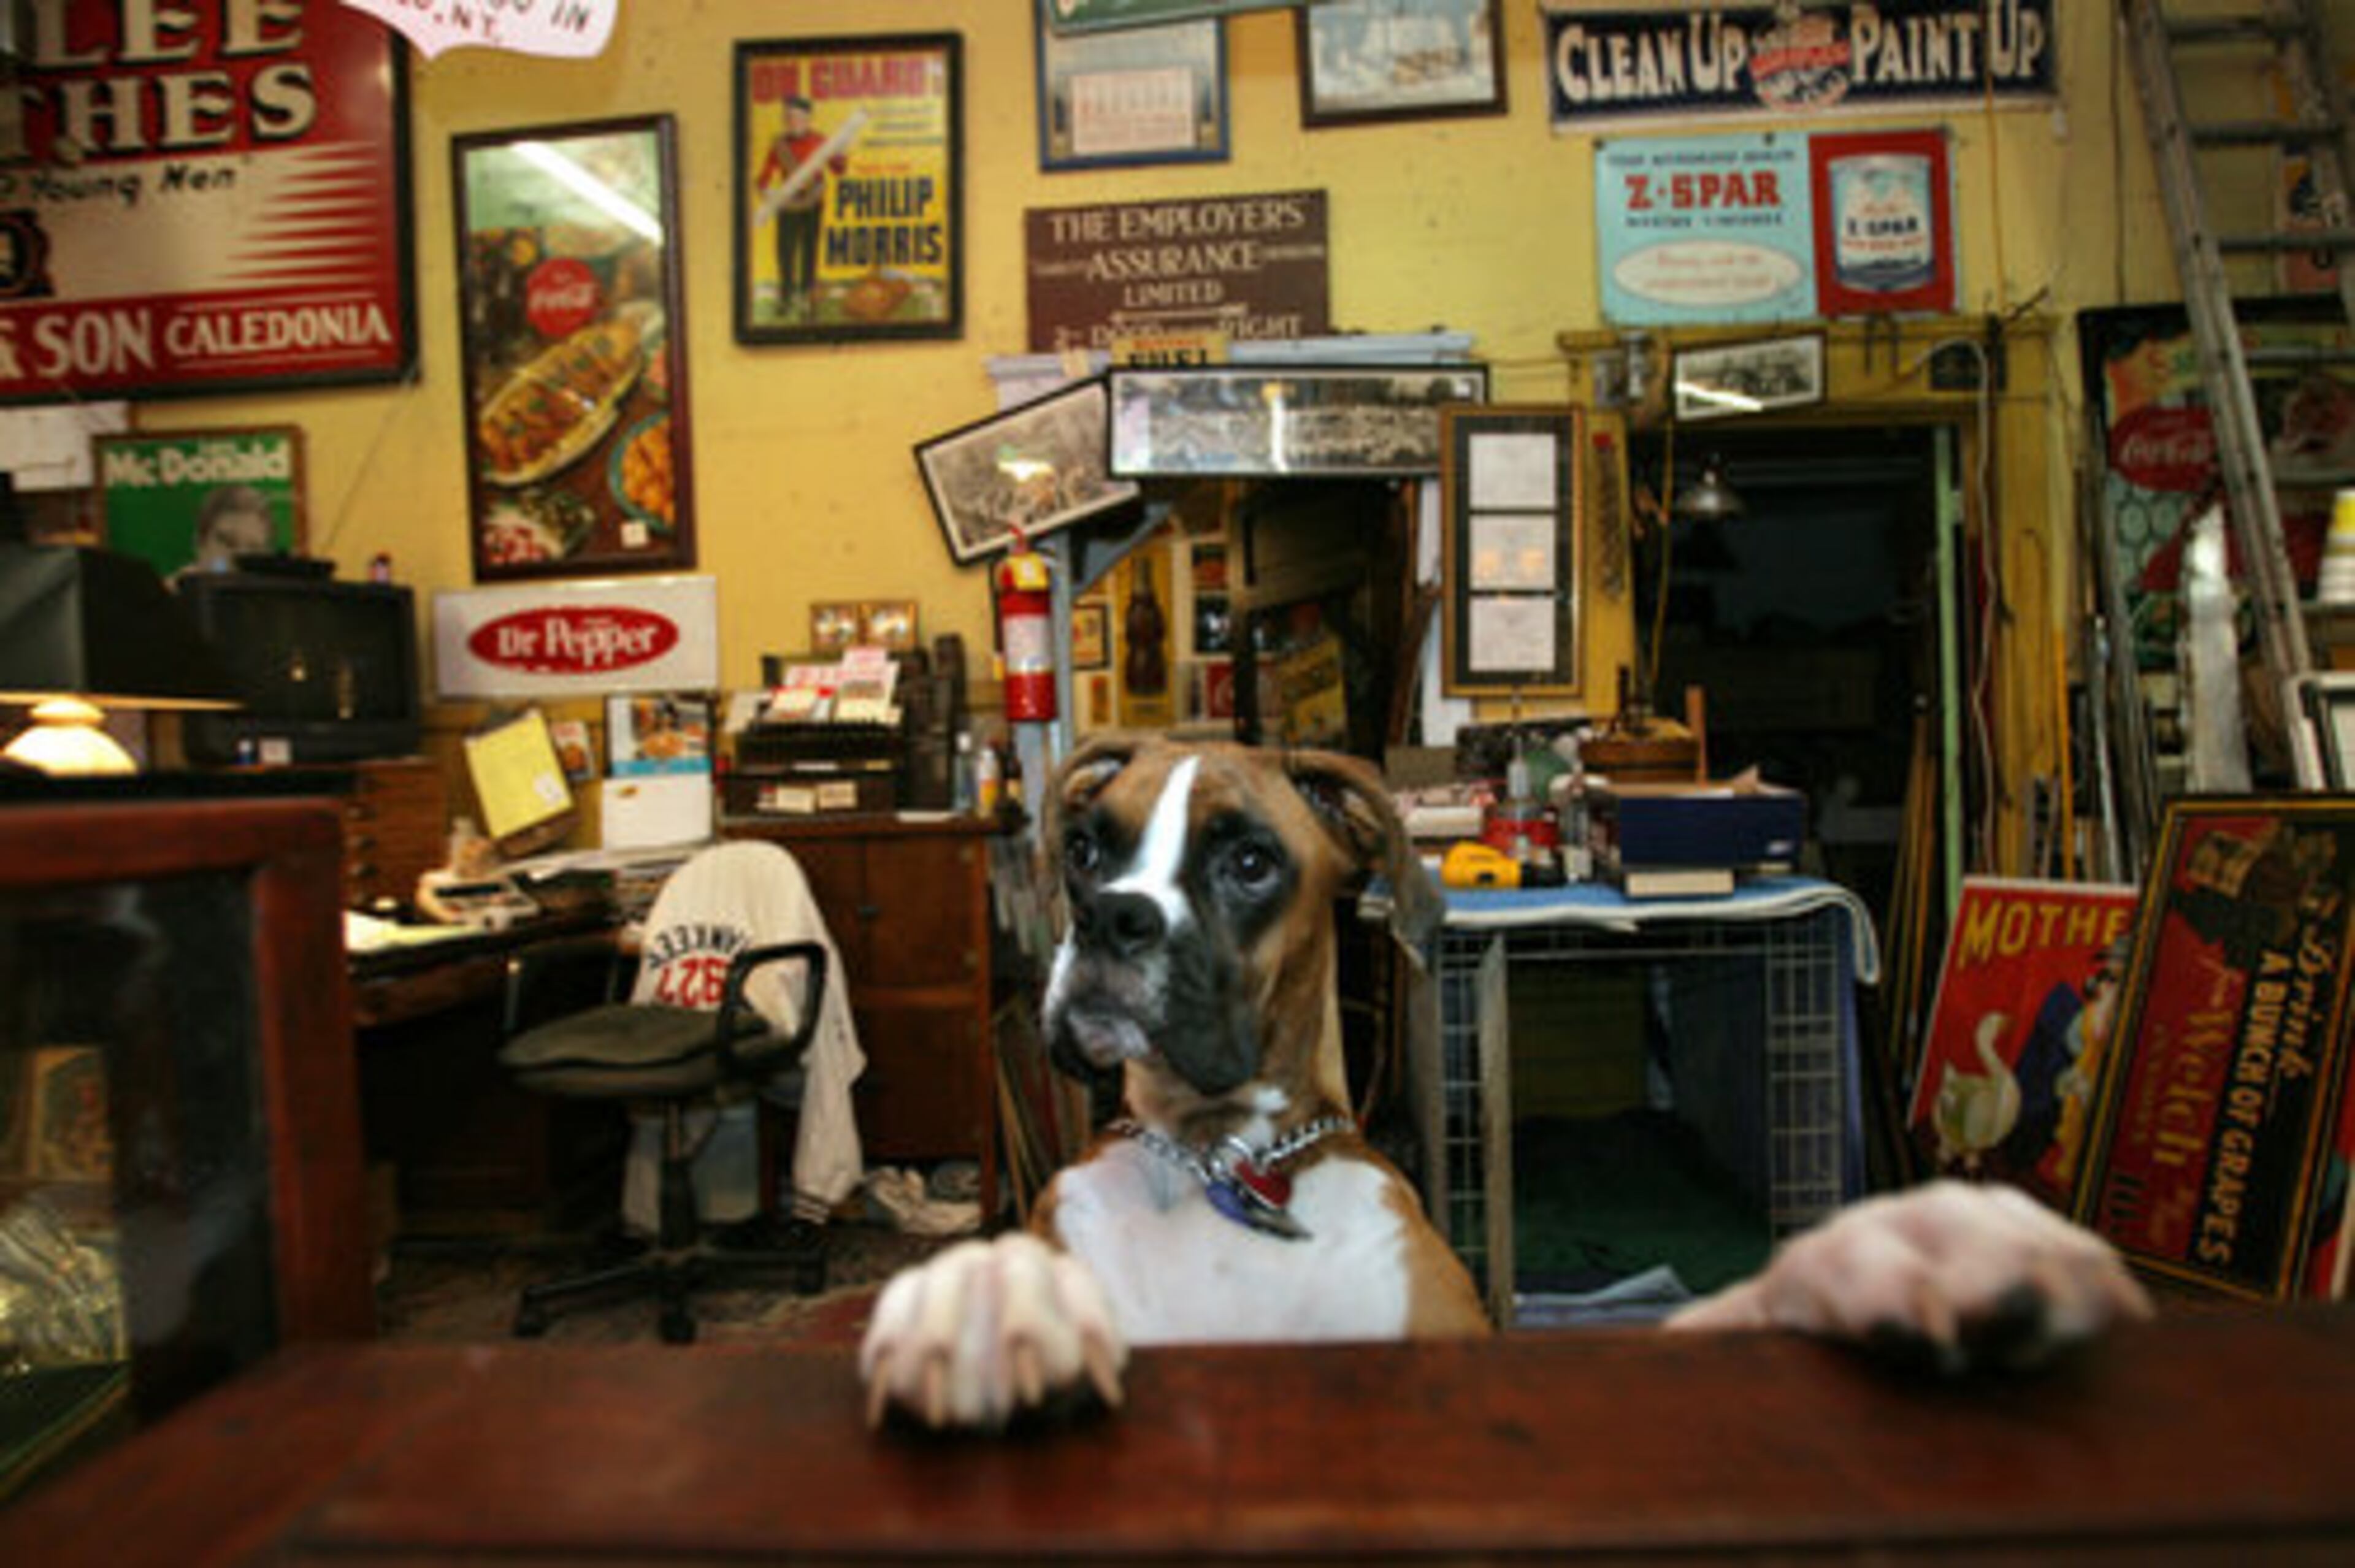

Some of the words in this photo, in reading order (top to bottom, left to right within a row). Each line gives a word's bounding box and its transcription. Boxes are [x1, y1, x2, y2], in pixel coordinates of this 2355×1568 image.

[1557, 23, 1687, 103] CLEAN
[1850, 8, 1980, 83] PAINT
[1989, 0, 2047, 78] UP
[158, 161, 238, 191] Men
[837, 176, 934, 220] PHILIP
[824, 224, 944, 267] MORRIS
[1050, 213, 1113, 244] THE
[1086, 241, 1262, 282] ASSURANCE
[1124, 281, 1225, 307] LIMITED
[33, 308, 156, 376] SON
[163, 305, 392, 357] CALEDONIA
[499, 626, 538, 657] Dr
[546, 617, 659, 667] Pepper
[2259, 947, 2294, 975] A
[2275, 925, 2335, 1079] Drink
[2235, 980, 2289, 1084] BUNCH
[2226, 1085, 2264, 1128] OF
[2196, 1127, 2254, 1264] GRAPES
